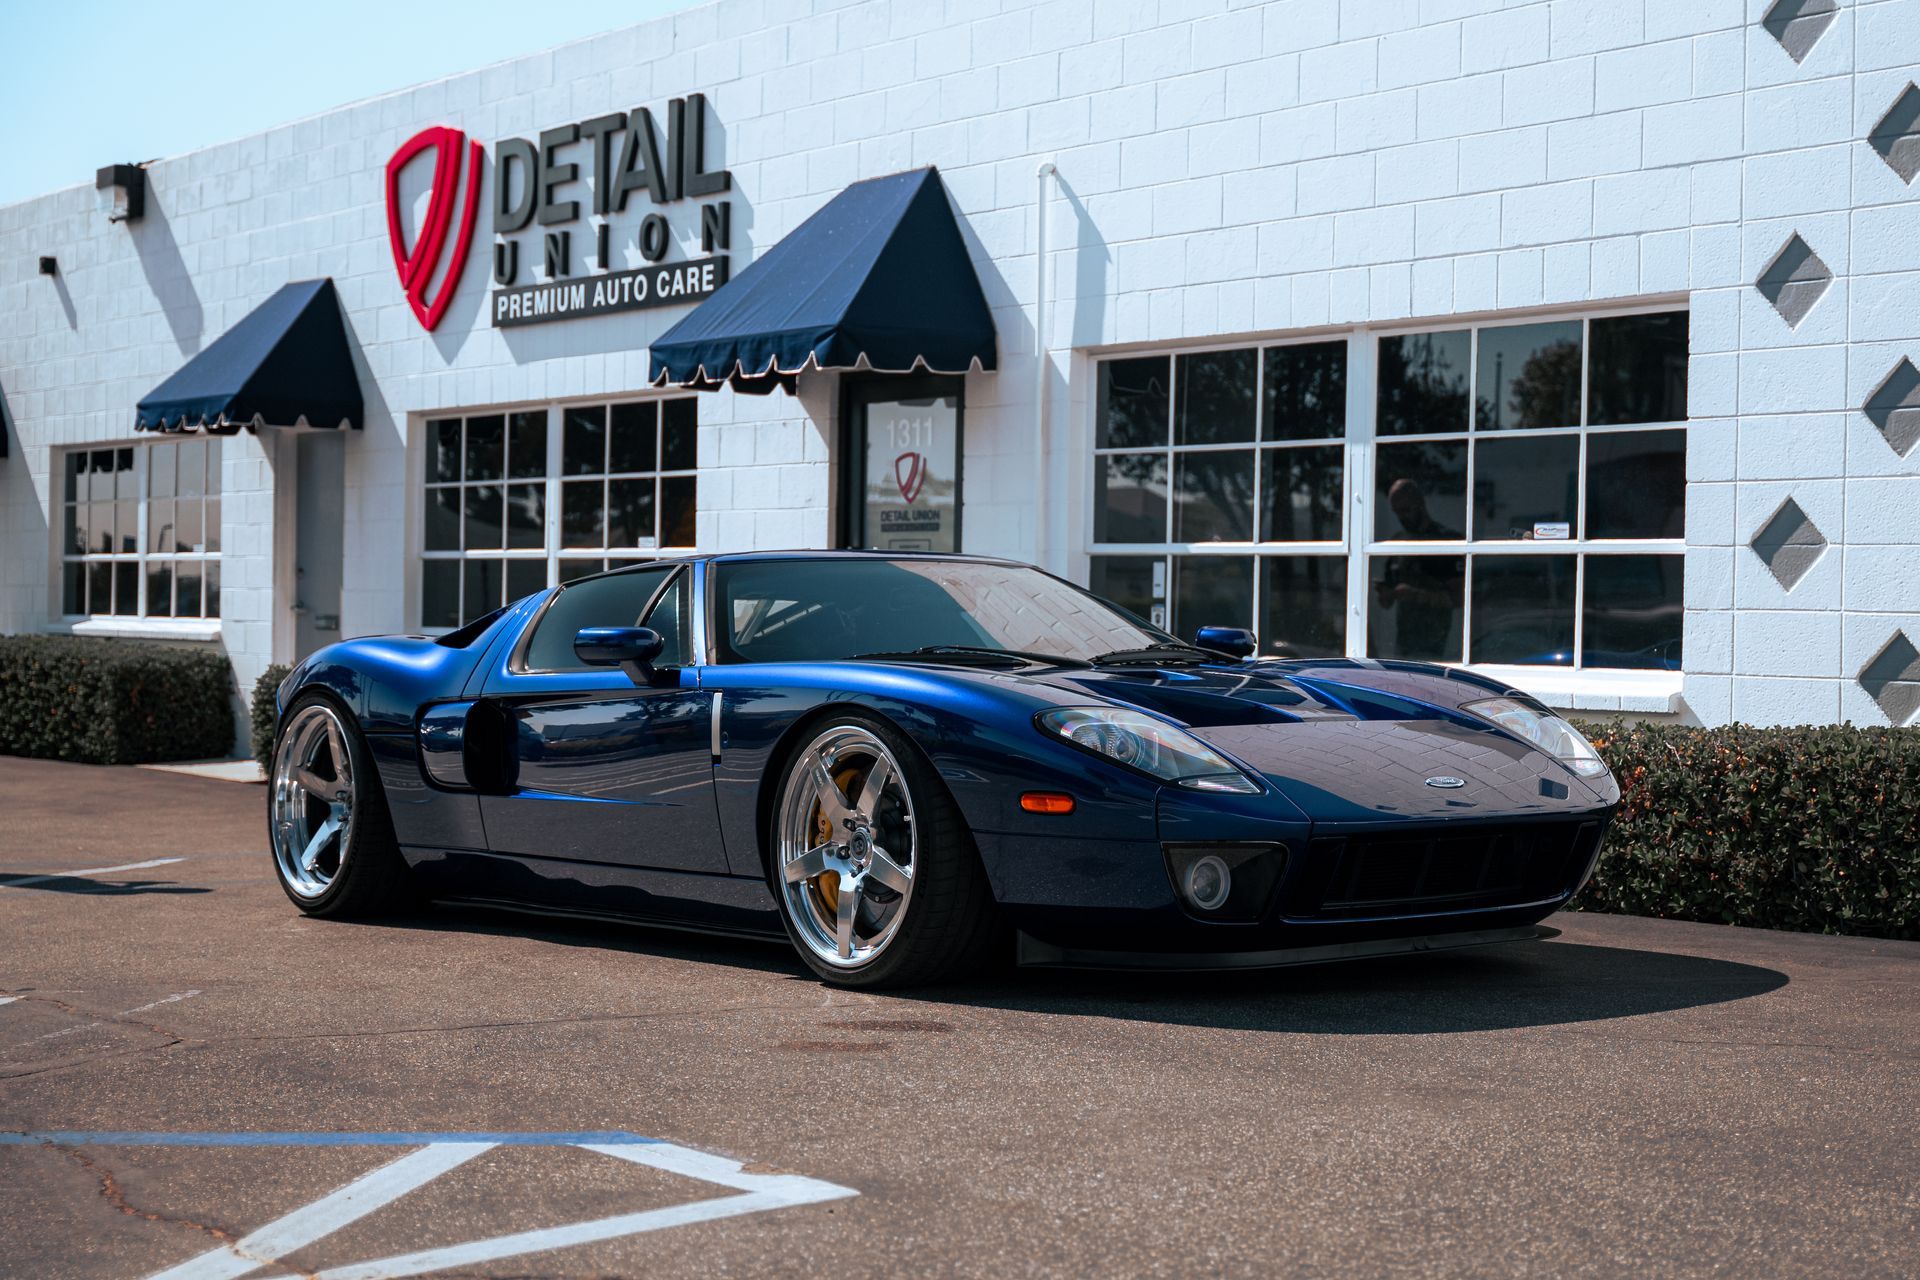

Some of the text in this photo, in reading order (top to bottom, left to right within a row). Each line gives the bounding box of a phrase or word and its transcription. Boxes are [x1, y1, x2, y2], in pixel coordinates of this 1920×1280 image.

[494, 93, 731, 233] DETAIL
[494, 202, 730, 286] UNION
[497, 264, 714, 320] PREMIUM AUTO CARE
[887, 416, 932, 448] 1311
[880, 509, 940, 522] DETAIL UNION
